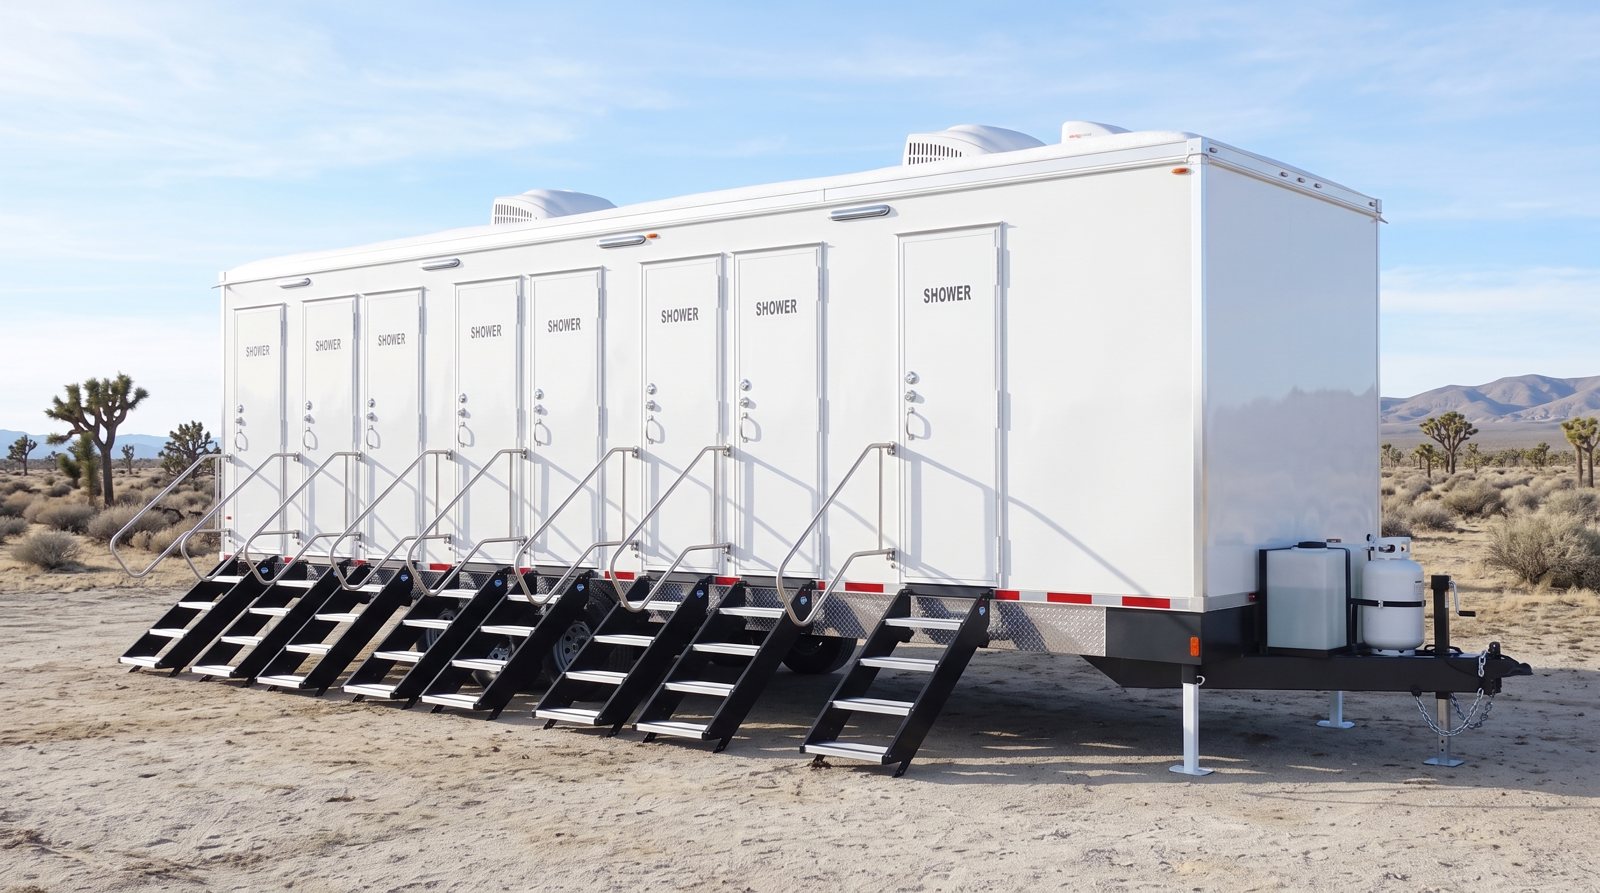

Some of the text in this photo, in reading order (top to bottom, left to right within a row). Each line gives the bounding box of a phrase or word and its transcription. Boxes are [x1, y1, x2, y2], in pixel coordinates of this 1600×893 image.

[923, 285, 972, 304] SHOWER
[755, 299, 798, 316] SHOWER
[661, 307, 699, 323] SHOWER
[470, 324, 502, 339] SHOWER
[547, 318, 581, 332] SHOWER
[315, 339, 342, 352] SHOWER
[378, 333, 406, 347] SHOWER
[246, 344, 270, 357] SHOWER
